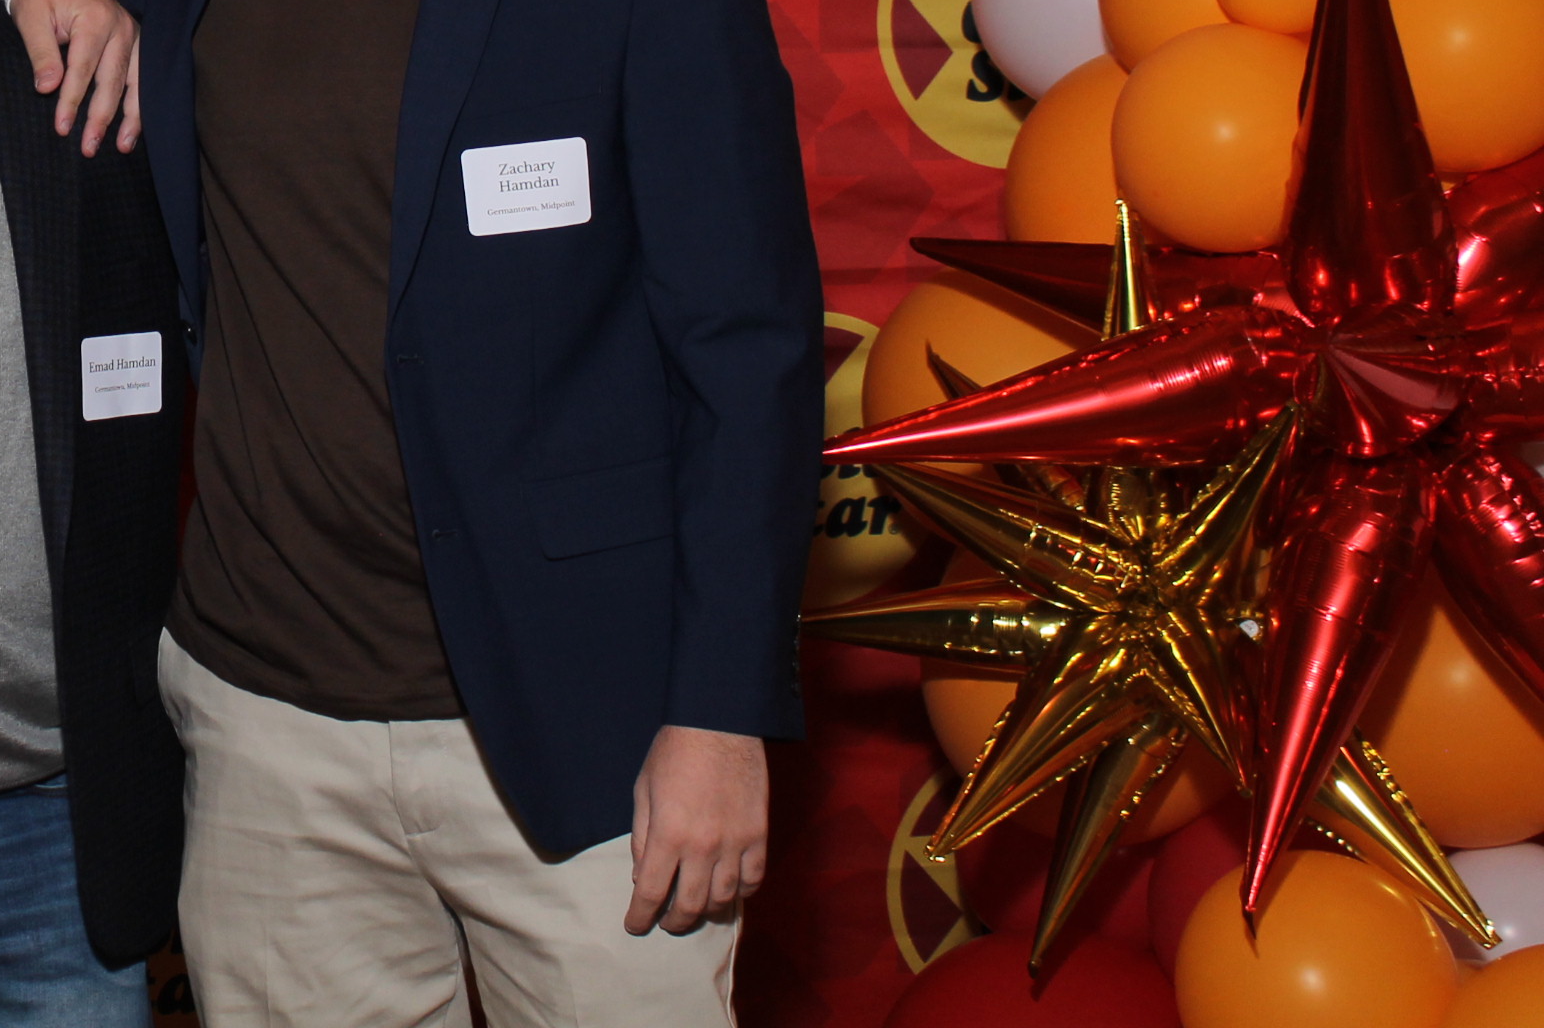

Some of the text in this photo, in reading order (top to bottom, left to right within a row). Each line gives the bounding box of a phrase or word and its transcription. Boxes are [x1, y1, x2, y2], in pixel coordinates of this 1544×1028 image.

[498, 160, 556, 176] Zachary
[499, 176, 560, 193] Hamdan
[487, 200, 576, 217] Germantown, Midpoint
[88, 355, 156, 373] Emad Hamdan
